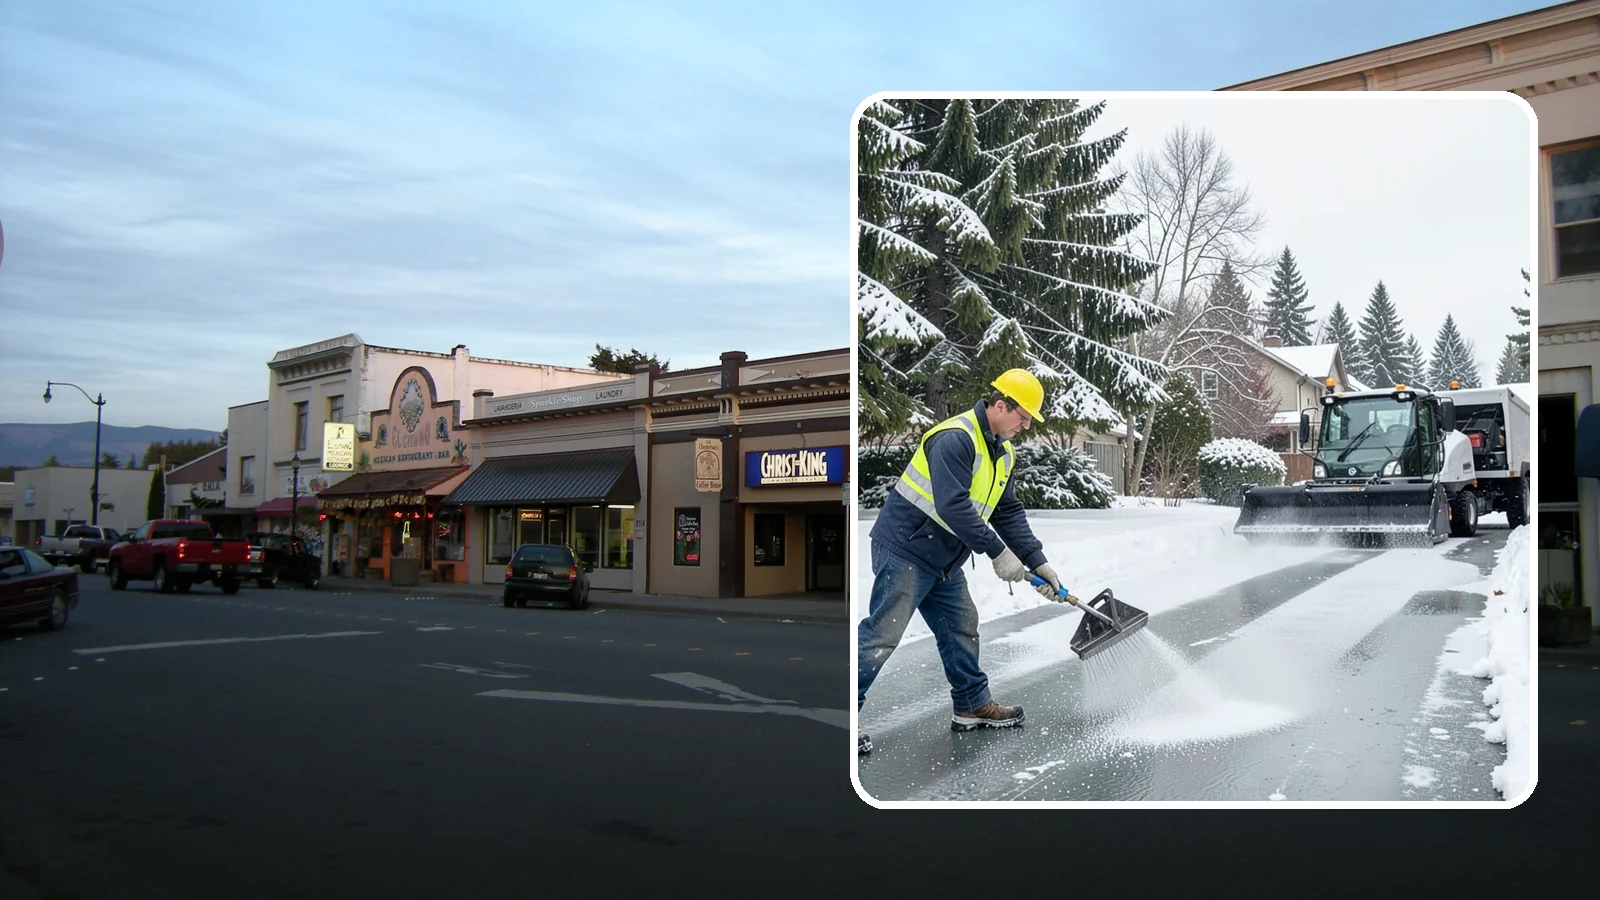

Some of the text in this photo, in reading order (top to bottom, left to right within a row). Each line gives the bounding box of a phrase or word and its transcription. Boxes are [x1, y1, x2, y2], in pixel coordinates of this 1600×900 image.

[494, 402, 522, 412] LAVANDERIA
[562, 394, 582, 404] Shop
[595, 388, 623, 400] LAUNDRY
[373, 450, 450, 464] MEXICAN RESTAURANT BAR
[761, 450, 827, 478] CHRIST KING
